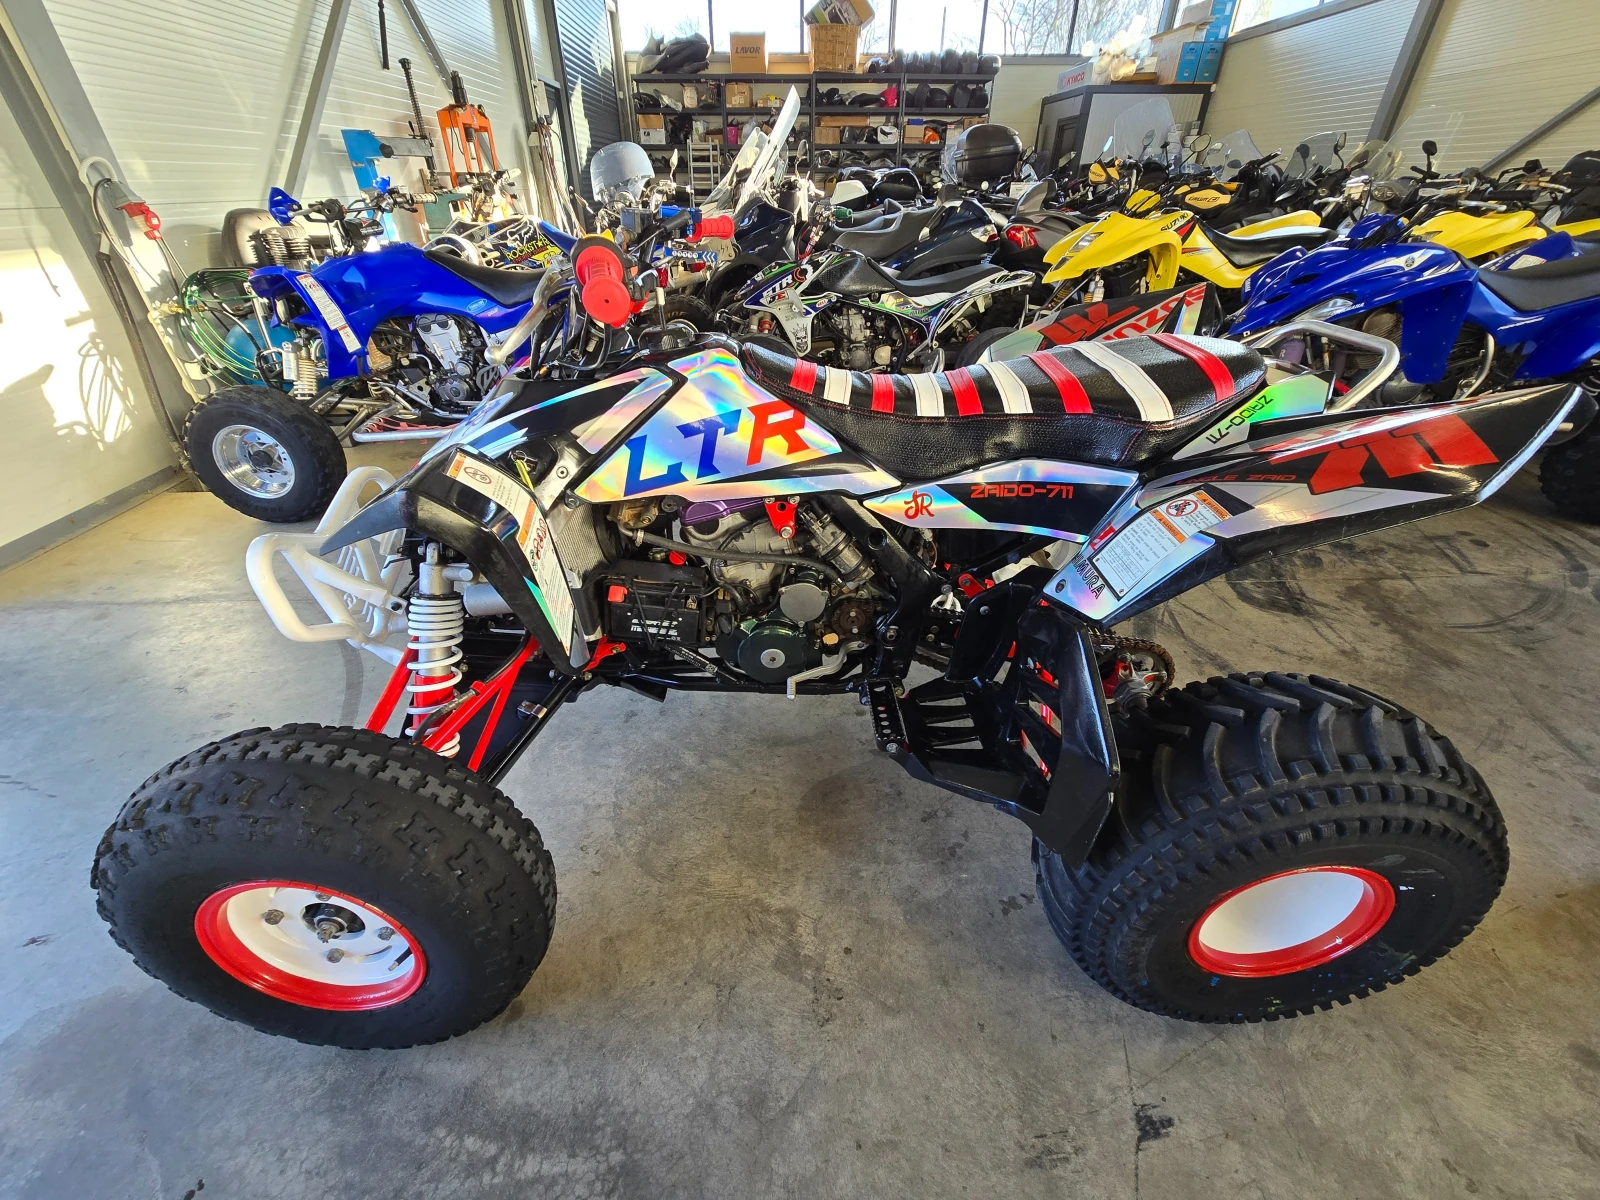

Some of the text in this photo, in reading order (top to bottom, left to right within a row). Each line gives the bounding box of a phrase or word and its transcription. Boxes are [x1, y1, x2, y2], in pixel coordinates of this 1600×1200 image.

[735, 46, 760, 54] LAVOR
[1066, 71, 1085, 86] KYMCO
[1206, 394, 1274, 444] ZAIDO-711
[624, 400, 811, 497] LTR
[1245, 474, 1297, 482] ZAID
[971, 484, 1074, 499] ZAIDO-711
